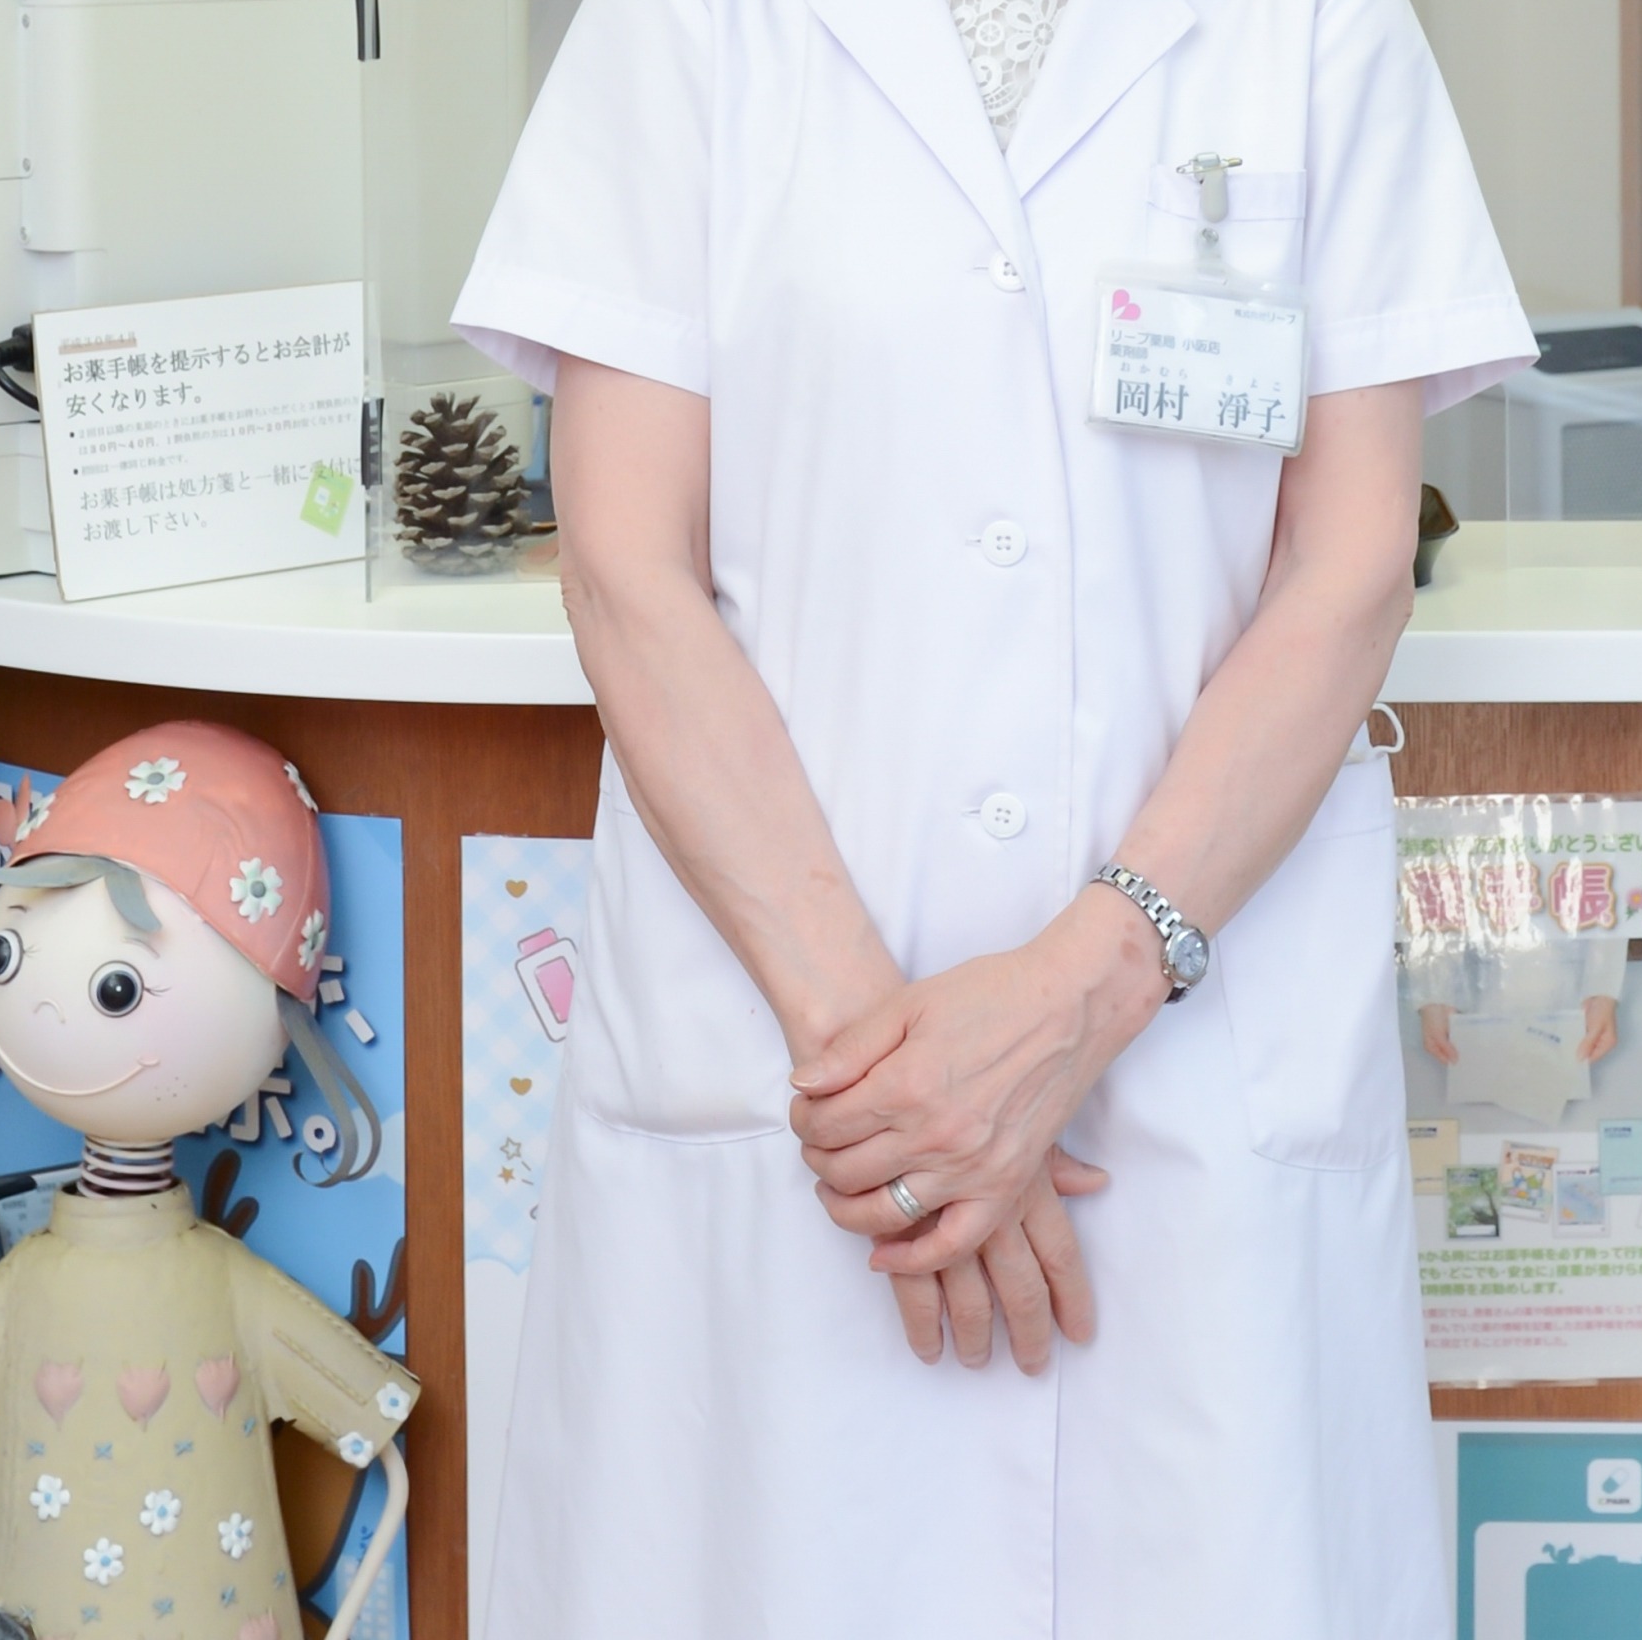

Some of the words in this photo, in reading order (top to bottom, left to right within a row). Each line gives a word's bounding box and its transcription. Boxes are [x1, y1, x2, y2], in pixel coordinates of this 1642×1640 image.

[63, 331, 352, 386] お薬手帳を提示するとお会計が
[1109, 343, 1149, 360] 薬剤師
[1119, 361, 1189, 380] おかむら
[1225, 374, 1282, 392] きよこ
[66, 381, 203, 419] 安くなります。
[1115, 378, 1190, 422] 岡村
[80, 456, 361, 511] お薬手帳は処方箋と一緒に受付に
[83, 510, 208, 543] お渡し下さい。
